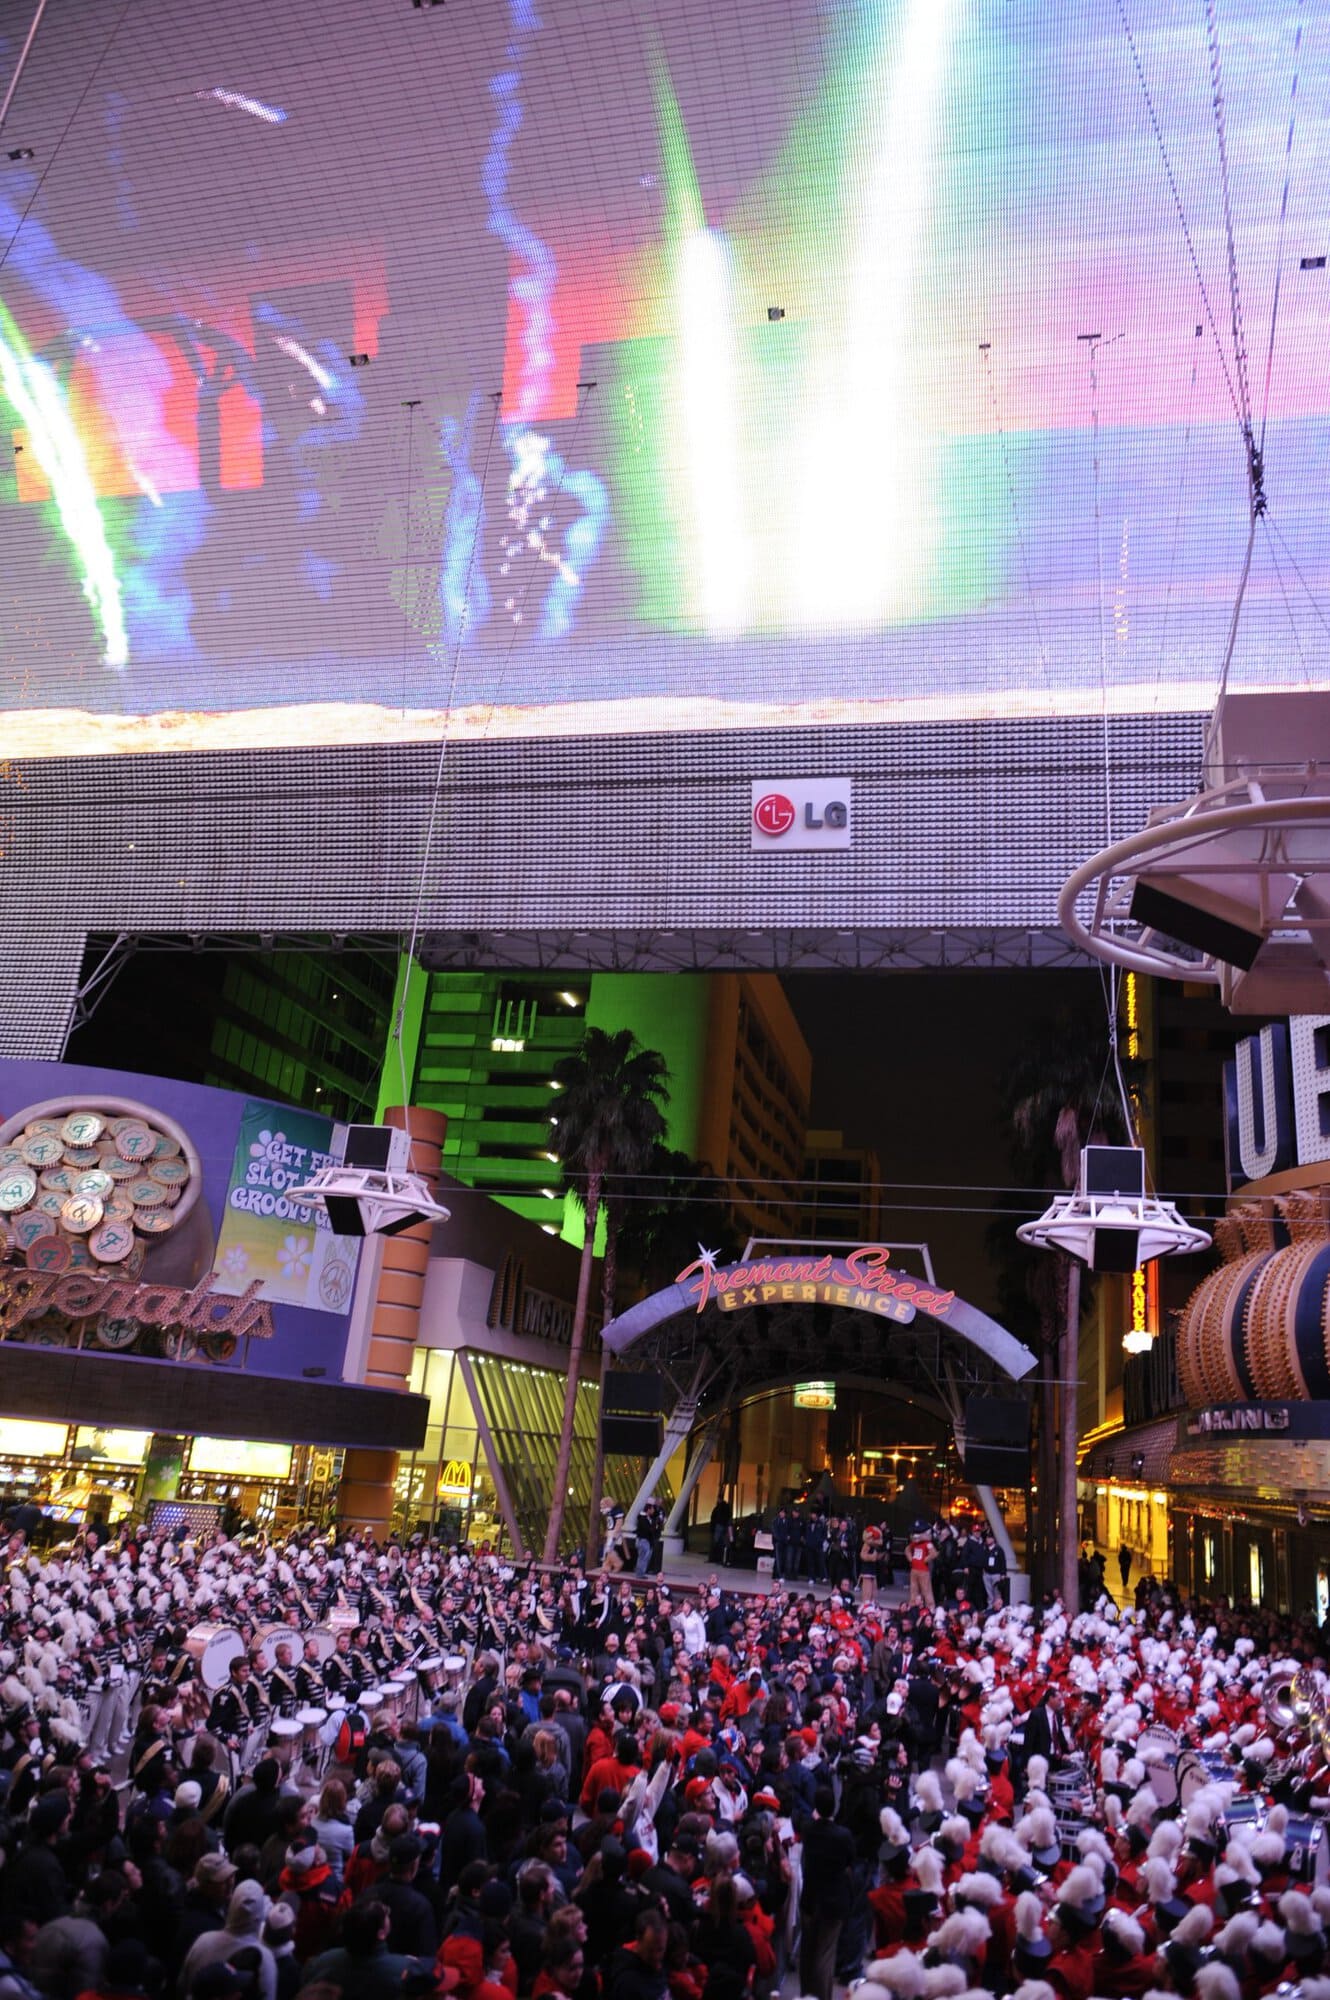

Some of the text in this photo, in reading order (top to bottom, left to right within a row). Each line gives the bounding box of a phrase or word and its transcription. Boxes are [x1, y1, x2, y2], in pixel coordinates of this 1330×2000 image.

[805, 801, 847, 829] LG
[266, 1141, 307, 1167] GET
[246, 1162, 299, 1190] SLOT
[675, 1247, 955, 1315] Fremont Street
[722, 1284, 910, 1318] EXPERIENCE
